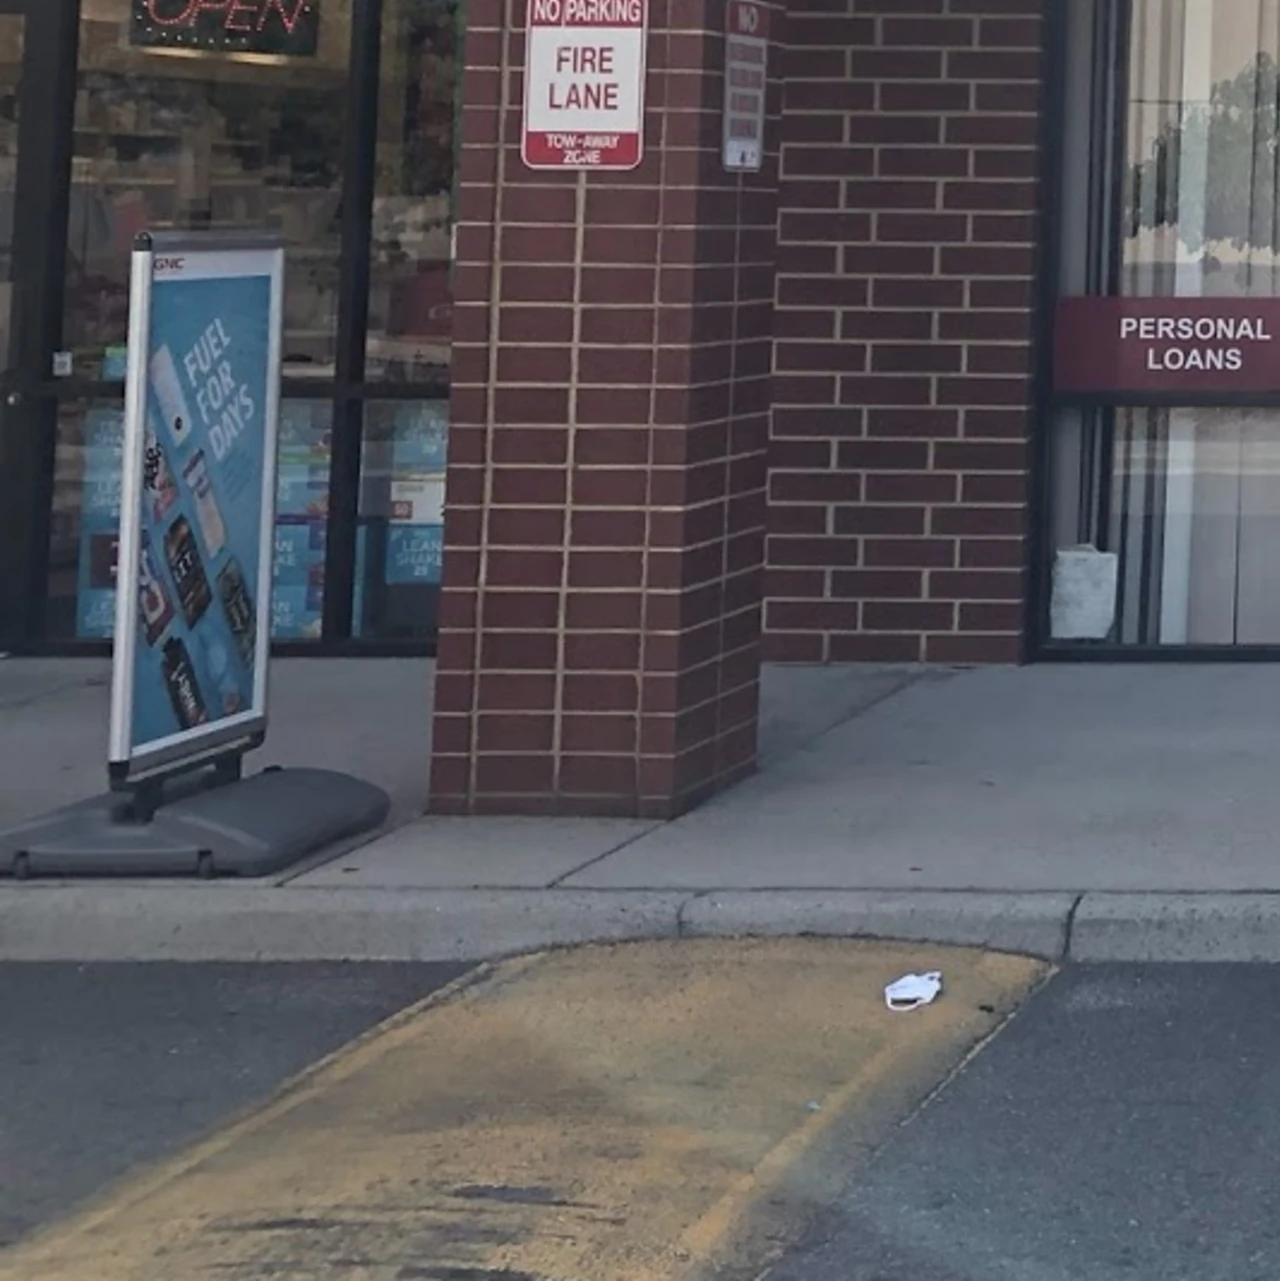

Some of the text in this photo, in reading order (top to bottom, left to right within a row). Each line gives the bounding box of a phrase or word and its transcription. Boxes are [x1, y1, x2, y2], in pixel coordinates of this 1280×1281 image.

[556, 47, 614, 73] FIRE
[549, 83, 618, 110] LANE
[545, 133, 620, 148] TOW-AWAY
[153, 258, 184, 270] GNC
[1119, 317, 1271, 341] PERSONAL
[183, 317, 231, 387] FUEL
[1146, 346, 1242, 371] LOANS
[196, 361, 236, 424] FOR
[208, 383, 255, 462] DAYS
